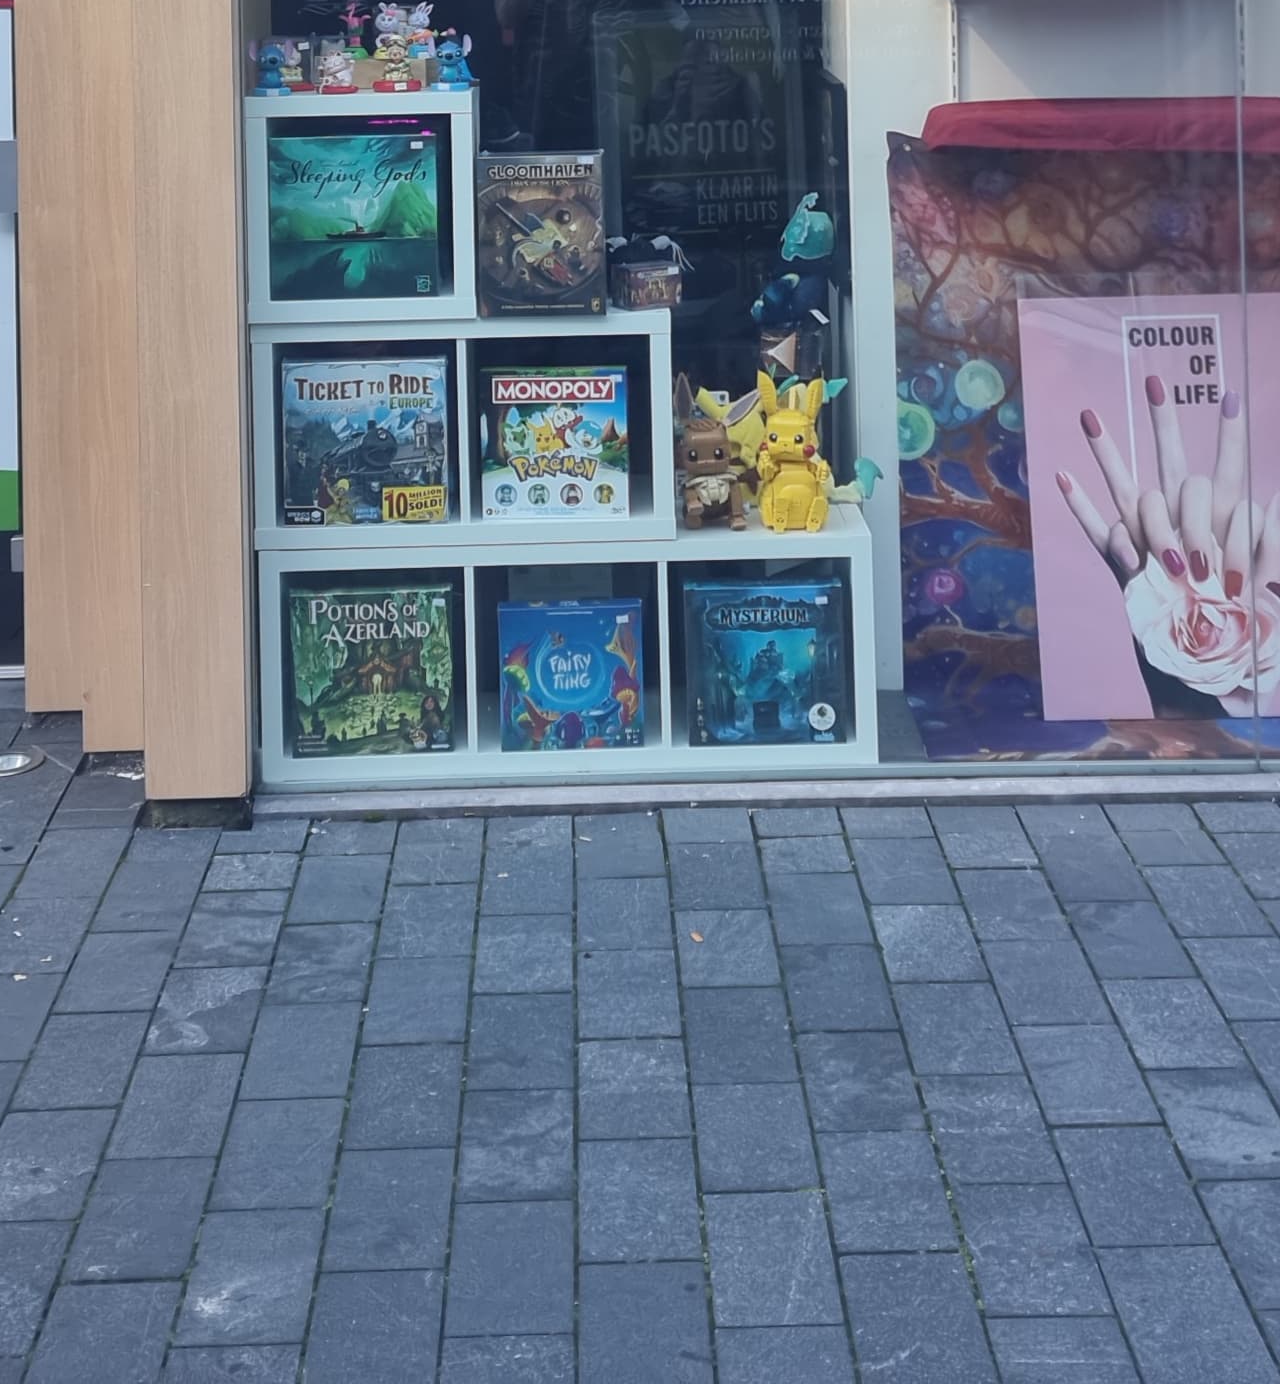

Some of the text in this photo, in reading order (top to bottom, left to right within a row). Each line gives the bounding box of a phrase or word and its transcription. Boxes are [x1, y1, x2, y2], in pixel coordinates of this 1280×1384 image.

[488, 165, 593, 180] GLOOMHAVEN
[1128, 327, 1215, 348] COLOUR
[1189, 355, 1216, 376] OF
[294, 373, 434, 401] TICKET TO RIDE
[497, 381, 611, 399] MONOPOLY
[1174, 384, 1219, 406] LIFE
[389, 397, 433, 409] EUROPE
[384, 489, 408, 519] 10
[408, 499, 443, 510] SOLD!
[309, 599, 418, 624] POTIONS OF
[719, 608, 809, 627] MYSTERIUM
[321, 621, 430, 648] AZERLAND
